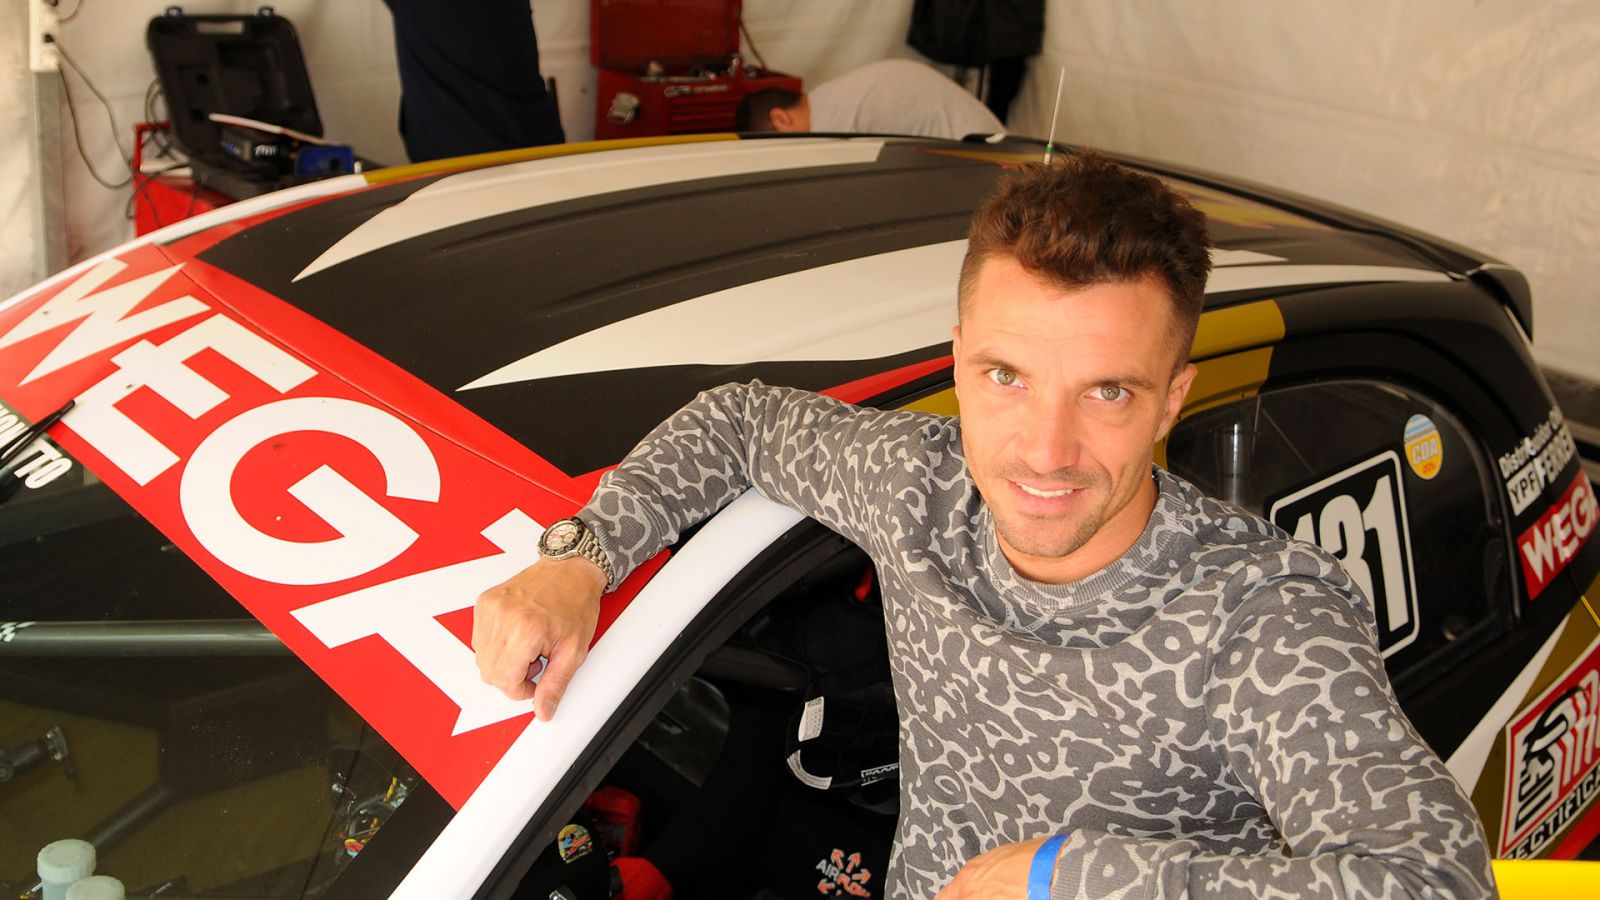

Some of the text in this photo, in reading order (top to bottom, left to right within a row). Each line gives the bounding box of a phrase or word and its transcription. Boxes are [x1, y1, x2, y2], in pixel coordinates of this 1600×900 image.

[0, 258, 546, 736] WEGA
[1510, 471, 1535, 504] YPF
[815, 859, 840, 882] AIR
